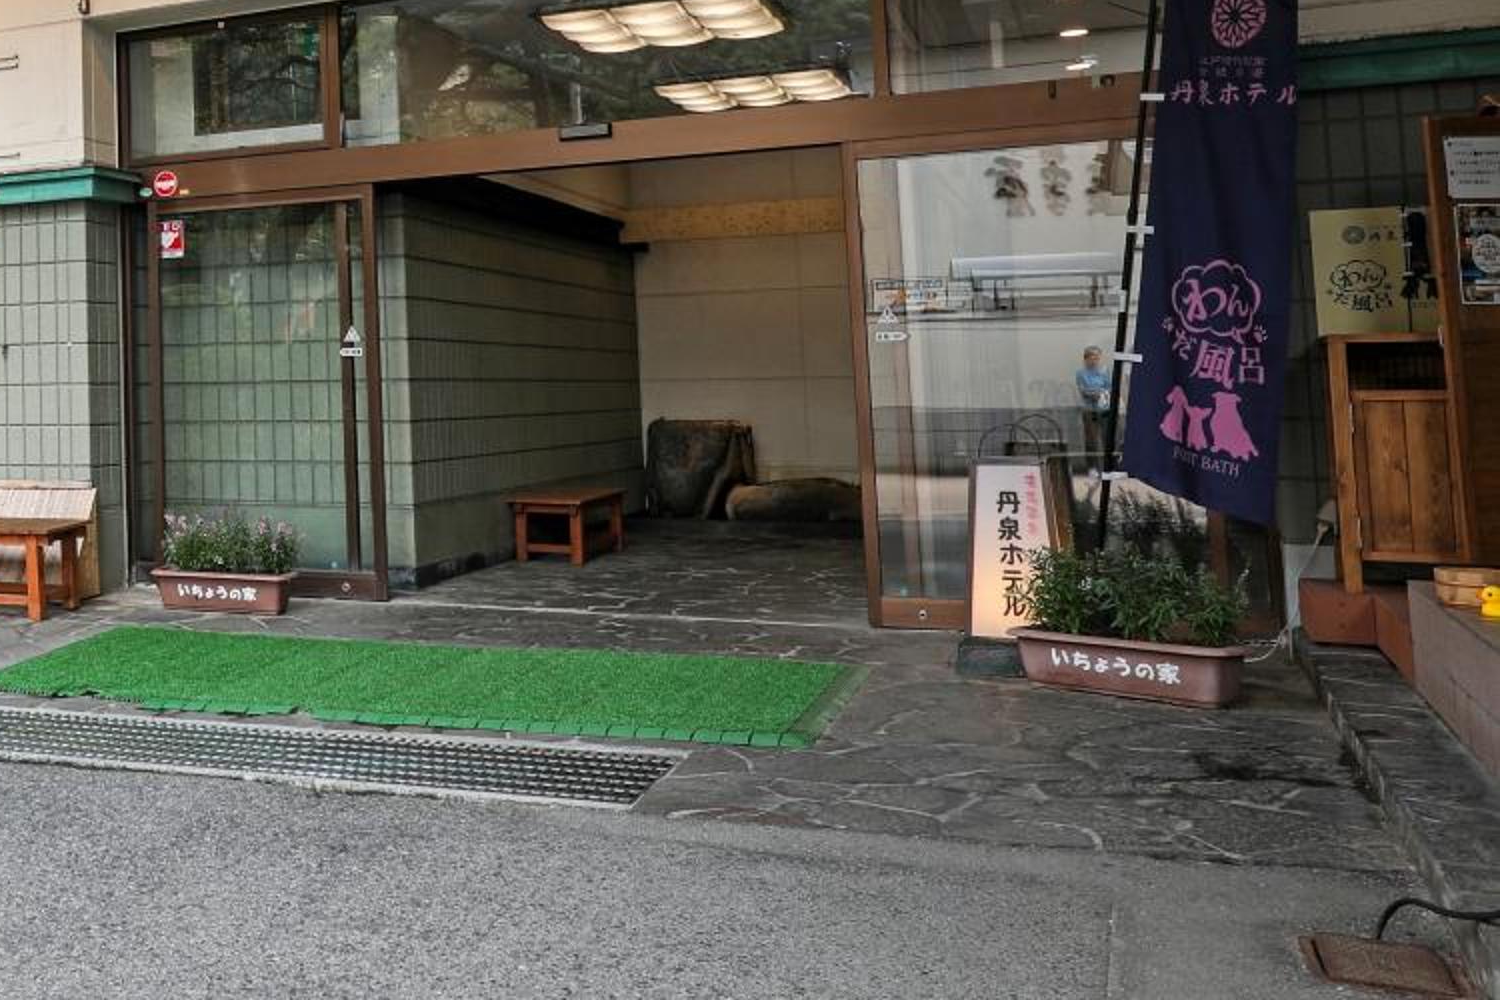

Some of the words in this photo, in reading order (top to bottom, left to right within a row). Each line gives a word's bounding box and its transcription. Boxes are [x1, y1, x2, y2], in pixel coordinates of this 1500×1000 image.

[1170, 80, 1297, 105] 丹泉ホテル
[1182, 278, 1249, 324] わん
[1201, 455, 1240, 478] BATH
[996, 491, 1027, 617] 丹泉ホテル
[177, 583, 258, 601] いちょうの家
[1051, 647, 1181, 685] いちょうの家
